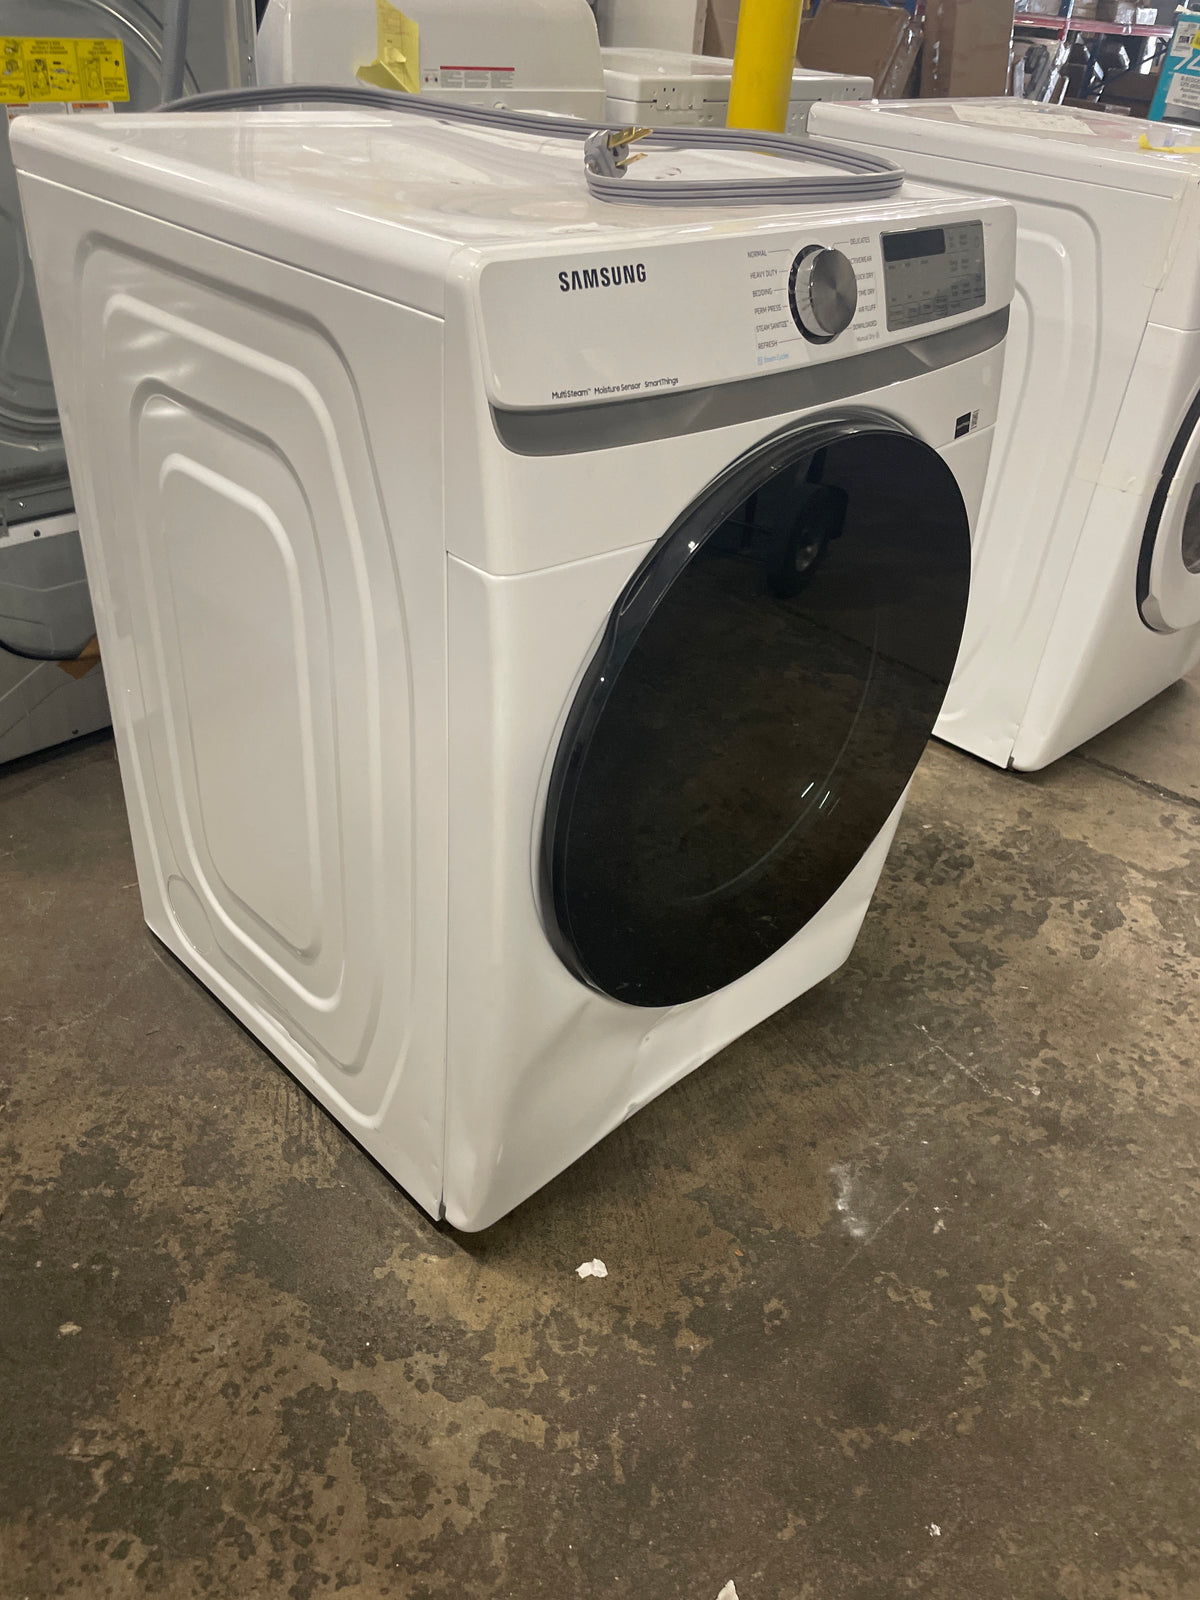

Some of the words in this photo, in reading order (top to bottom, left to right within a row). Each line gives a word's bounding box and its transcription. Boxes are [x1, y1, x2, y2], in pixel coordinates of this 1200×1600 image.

[747, 250, 767, 258] NORMAL
[850, 255, 872, 264] CTIVEWEAR
[558, 263, 646, 292] SAMSUNG
[750, 271, 765, 279] HEAVY
[765, 269, 777, 278] DUTY
[752, 288, 773, 297] BEDDING
[754, 306, 767, 315] PERM
[767, 304, 781, 312] PRESS
[756, 324, 770, 332] STEAM
[758, 340, 777, 349] REFRESH
[594, 385, 620, 396] Moisture
[621, 382, 641, 391] Sensor
[644, 377, 679, 388] SmartThings
